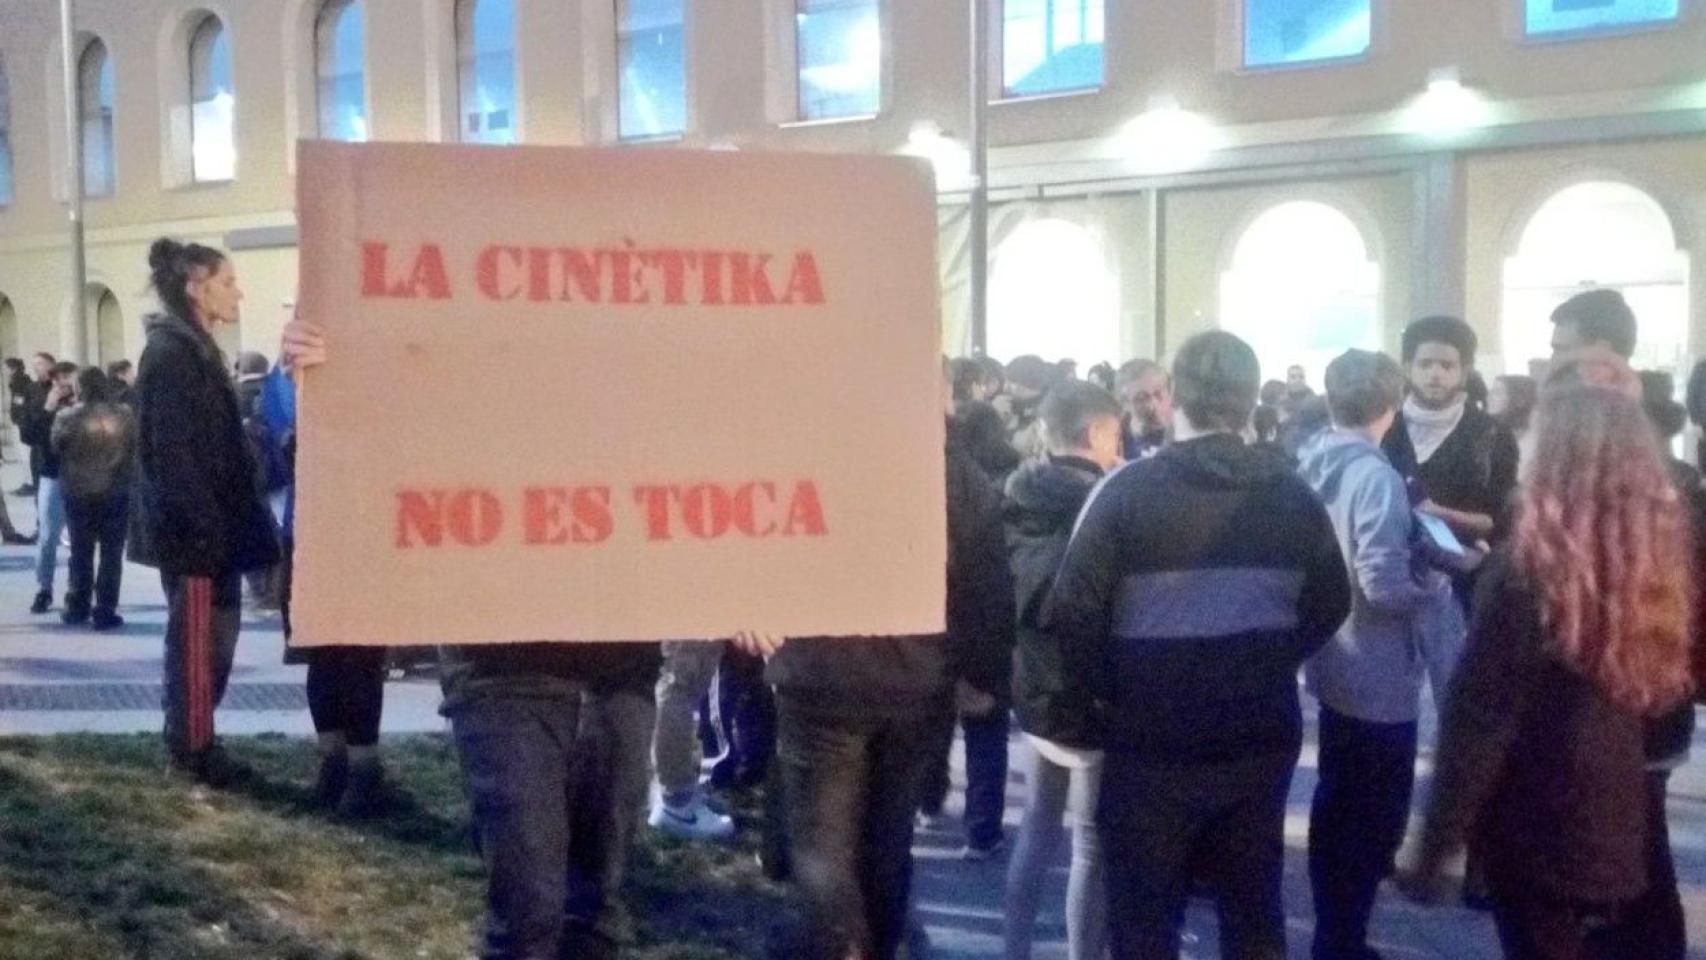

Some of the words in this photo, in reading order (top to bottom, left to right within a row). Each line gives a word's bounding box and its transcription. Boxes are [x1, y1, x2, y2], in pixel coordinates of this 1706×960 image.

[360, 240, 452, 299] LA
[474, 236, 827, 305] CINÈTIKA
[394, 488, 503, 549] NO
[523, 485, 614, 545] ES
[632, 479, 829, 541] TOCA
